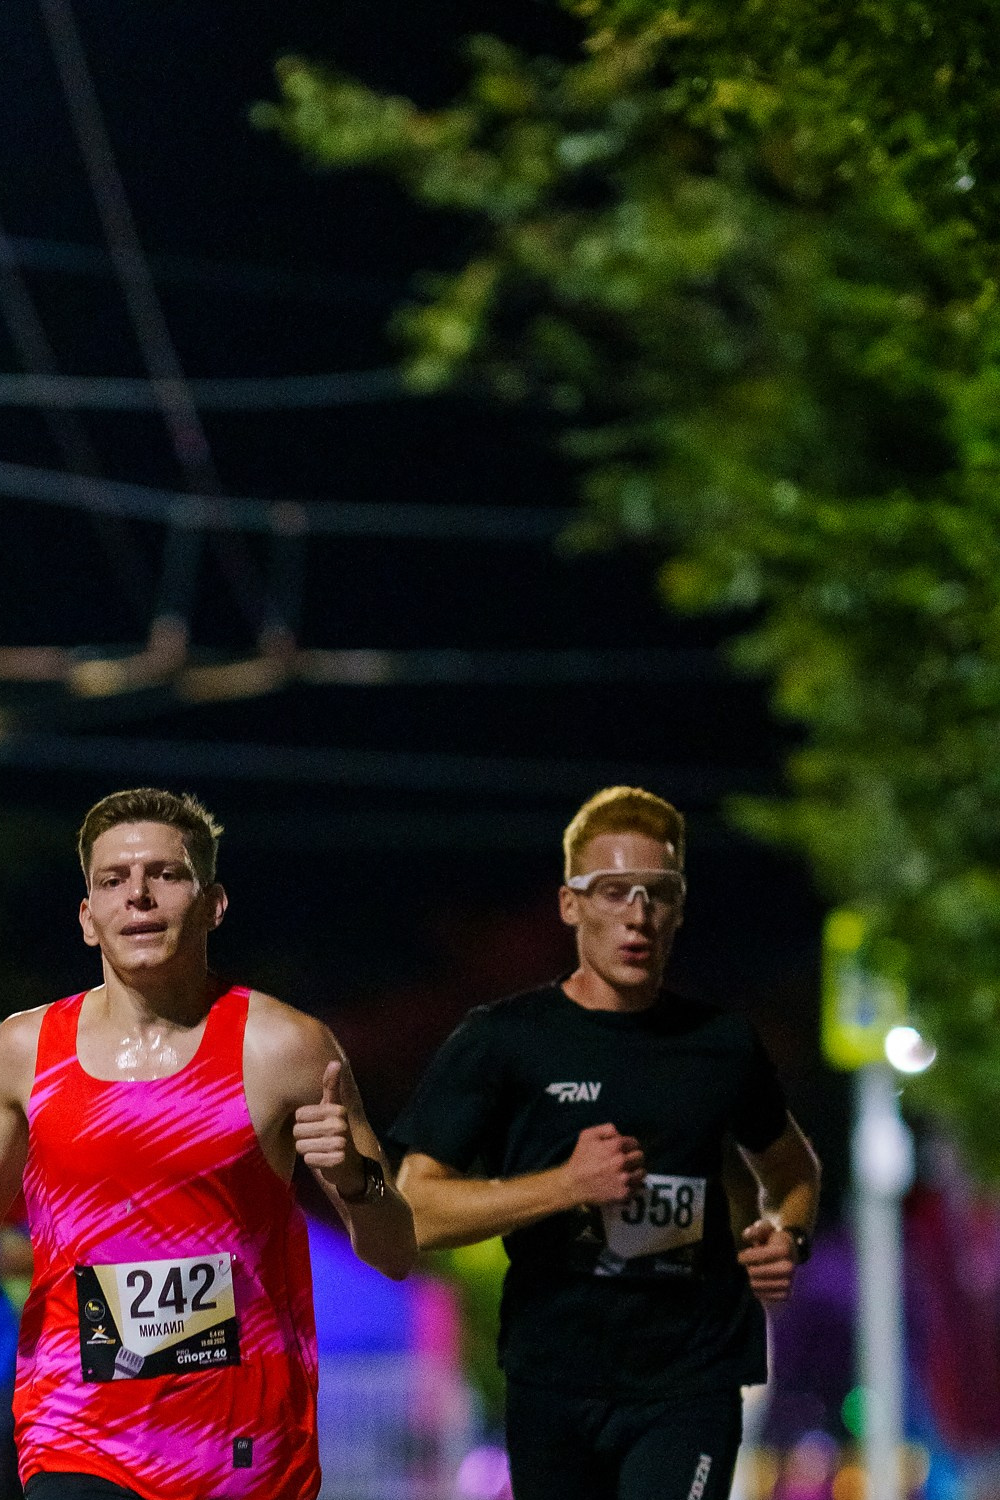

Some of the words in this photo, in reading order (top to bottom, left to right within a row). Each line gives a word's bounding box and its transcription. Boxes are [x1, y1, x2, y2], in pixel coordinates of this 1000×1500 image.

[126, 1263, 217, 1319] 242
[139, 1320, 185, 1338] МИХАИЛ
[177, 1350, 212, 1364] СПОРТ
[213, 1348, 227, 1358] 40
